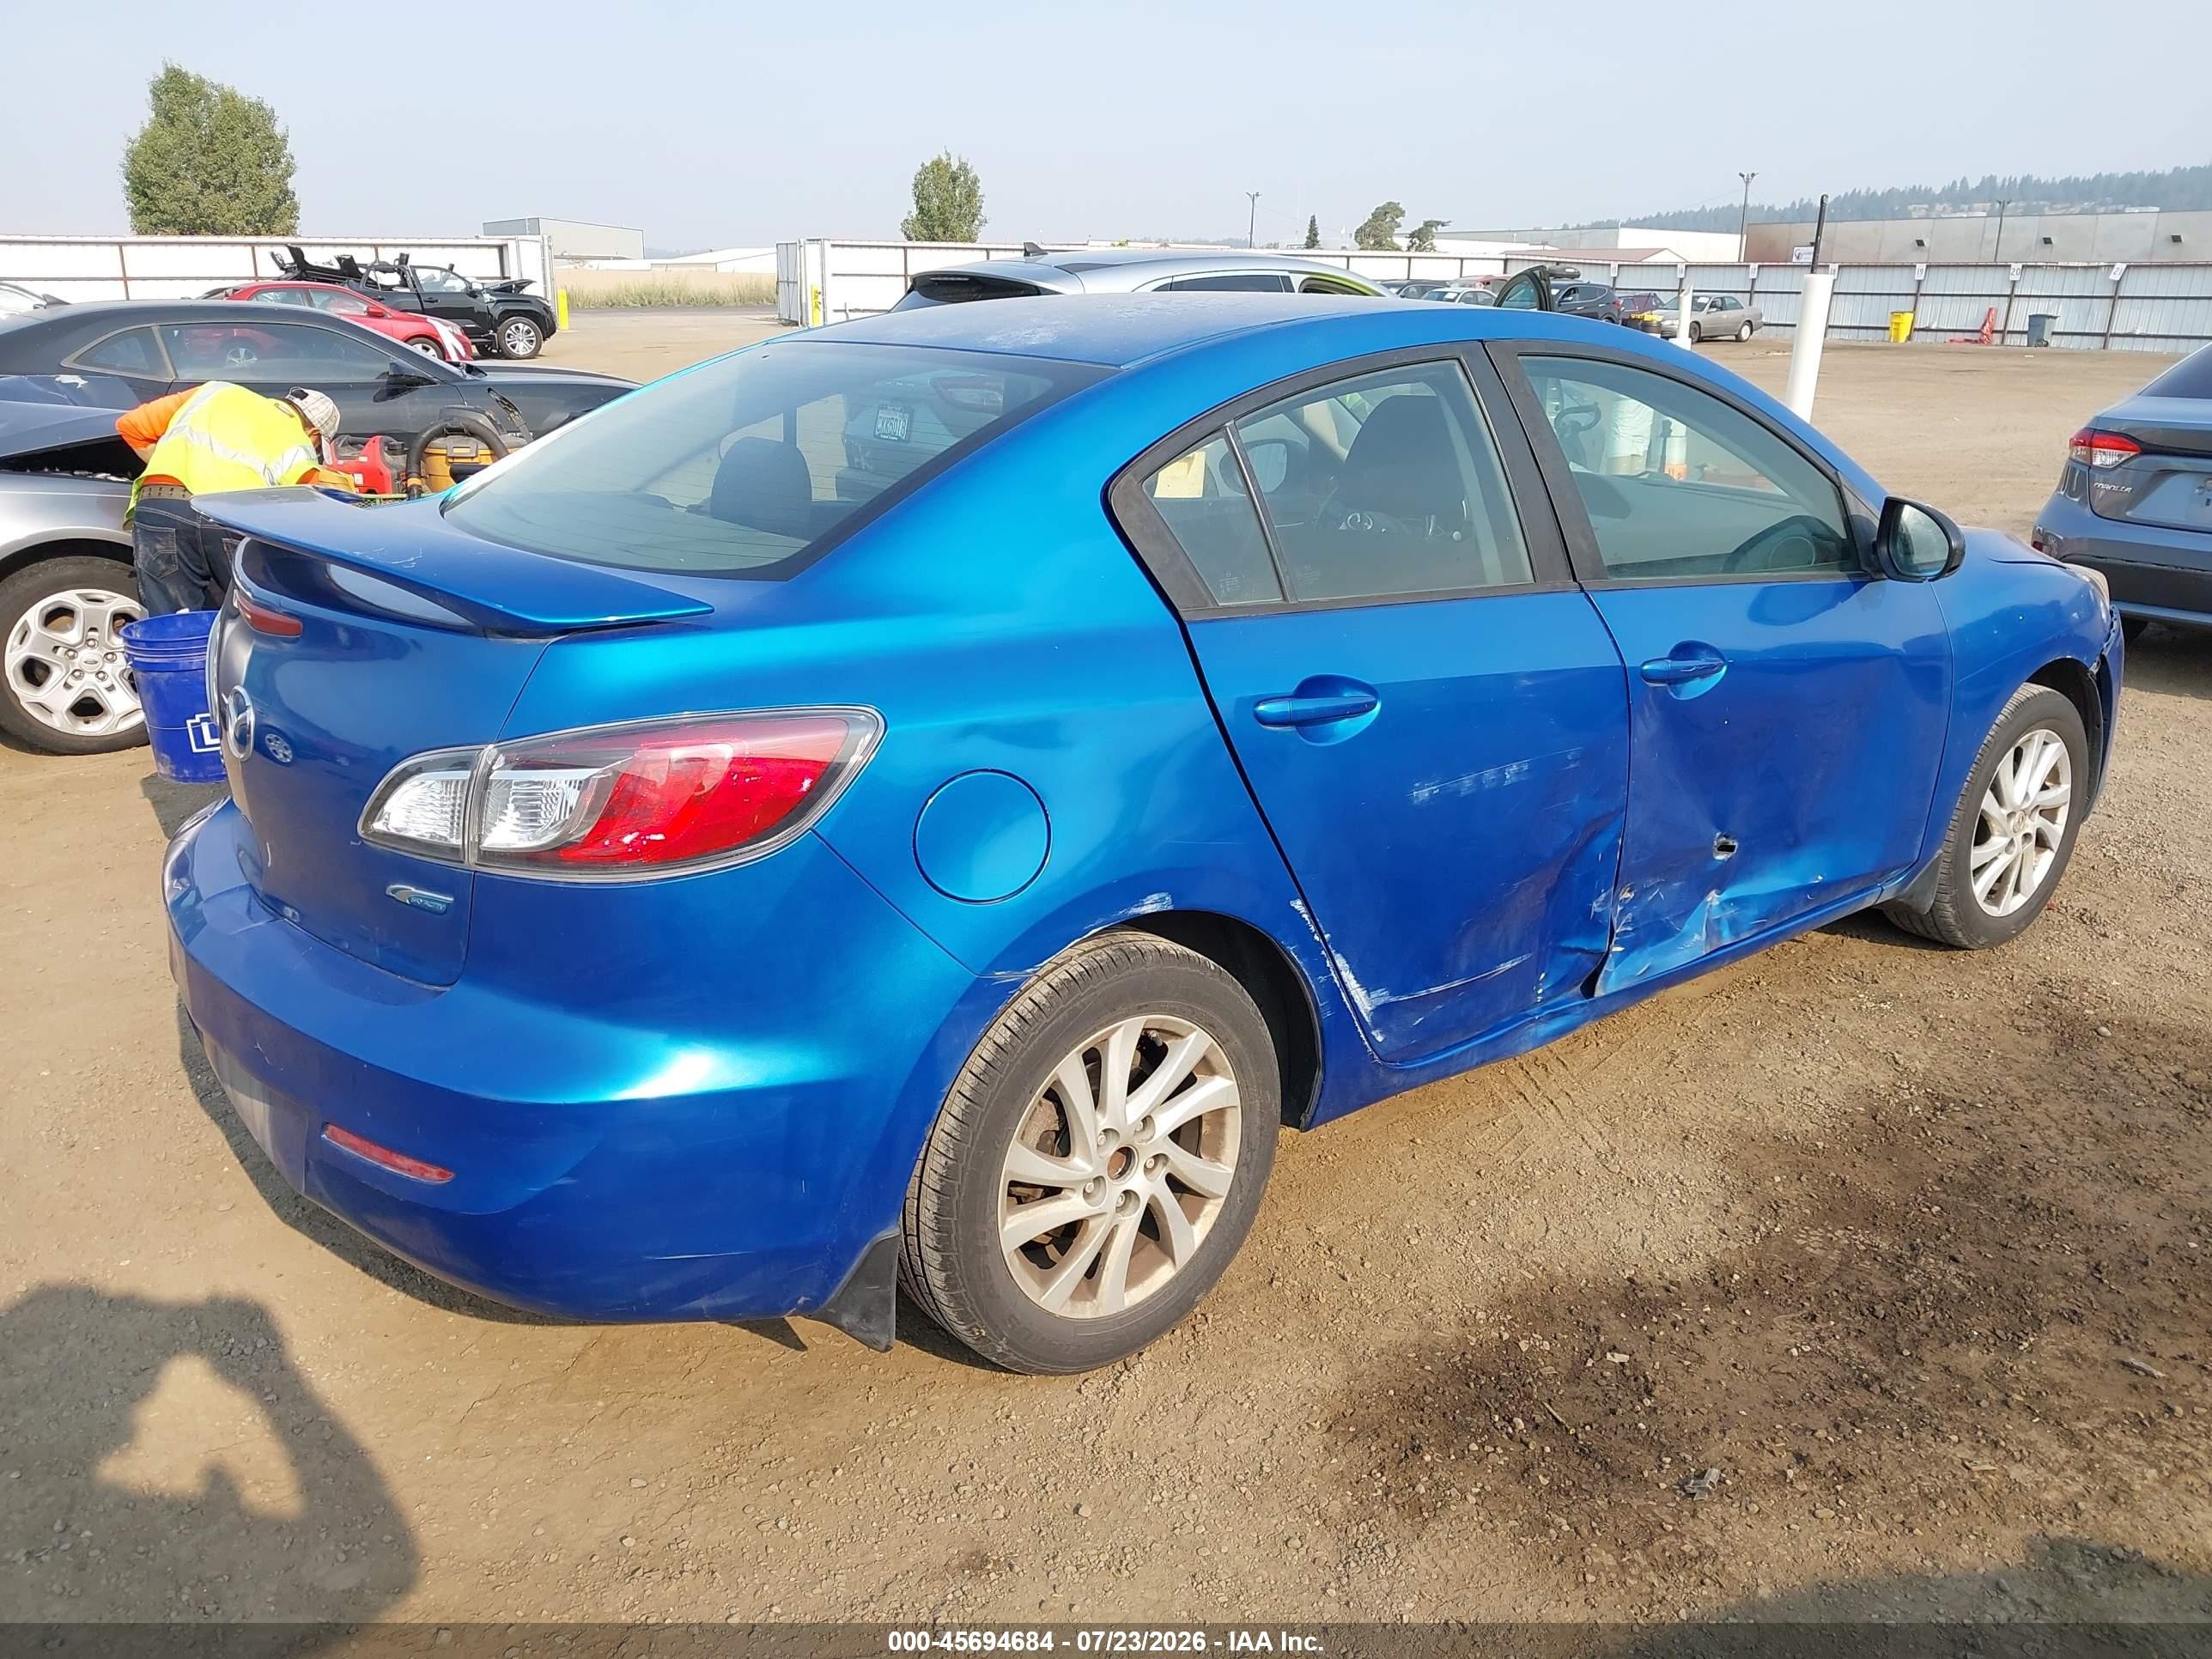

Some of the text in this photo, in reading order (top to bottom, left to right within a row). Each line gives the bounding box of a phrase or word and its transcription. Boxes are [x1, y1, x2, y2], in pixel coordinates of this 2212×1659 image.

[1917, 267, 1924, 276] 19
[2010, 267, 2021, 276] 20
[2112, 267, 2124, 276] 21
[2094, 482, 2132, 494] COROLLA
